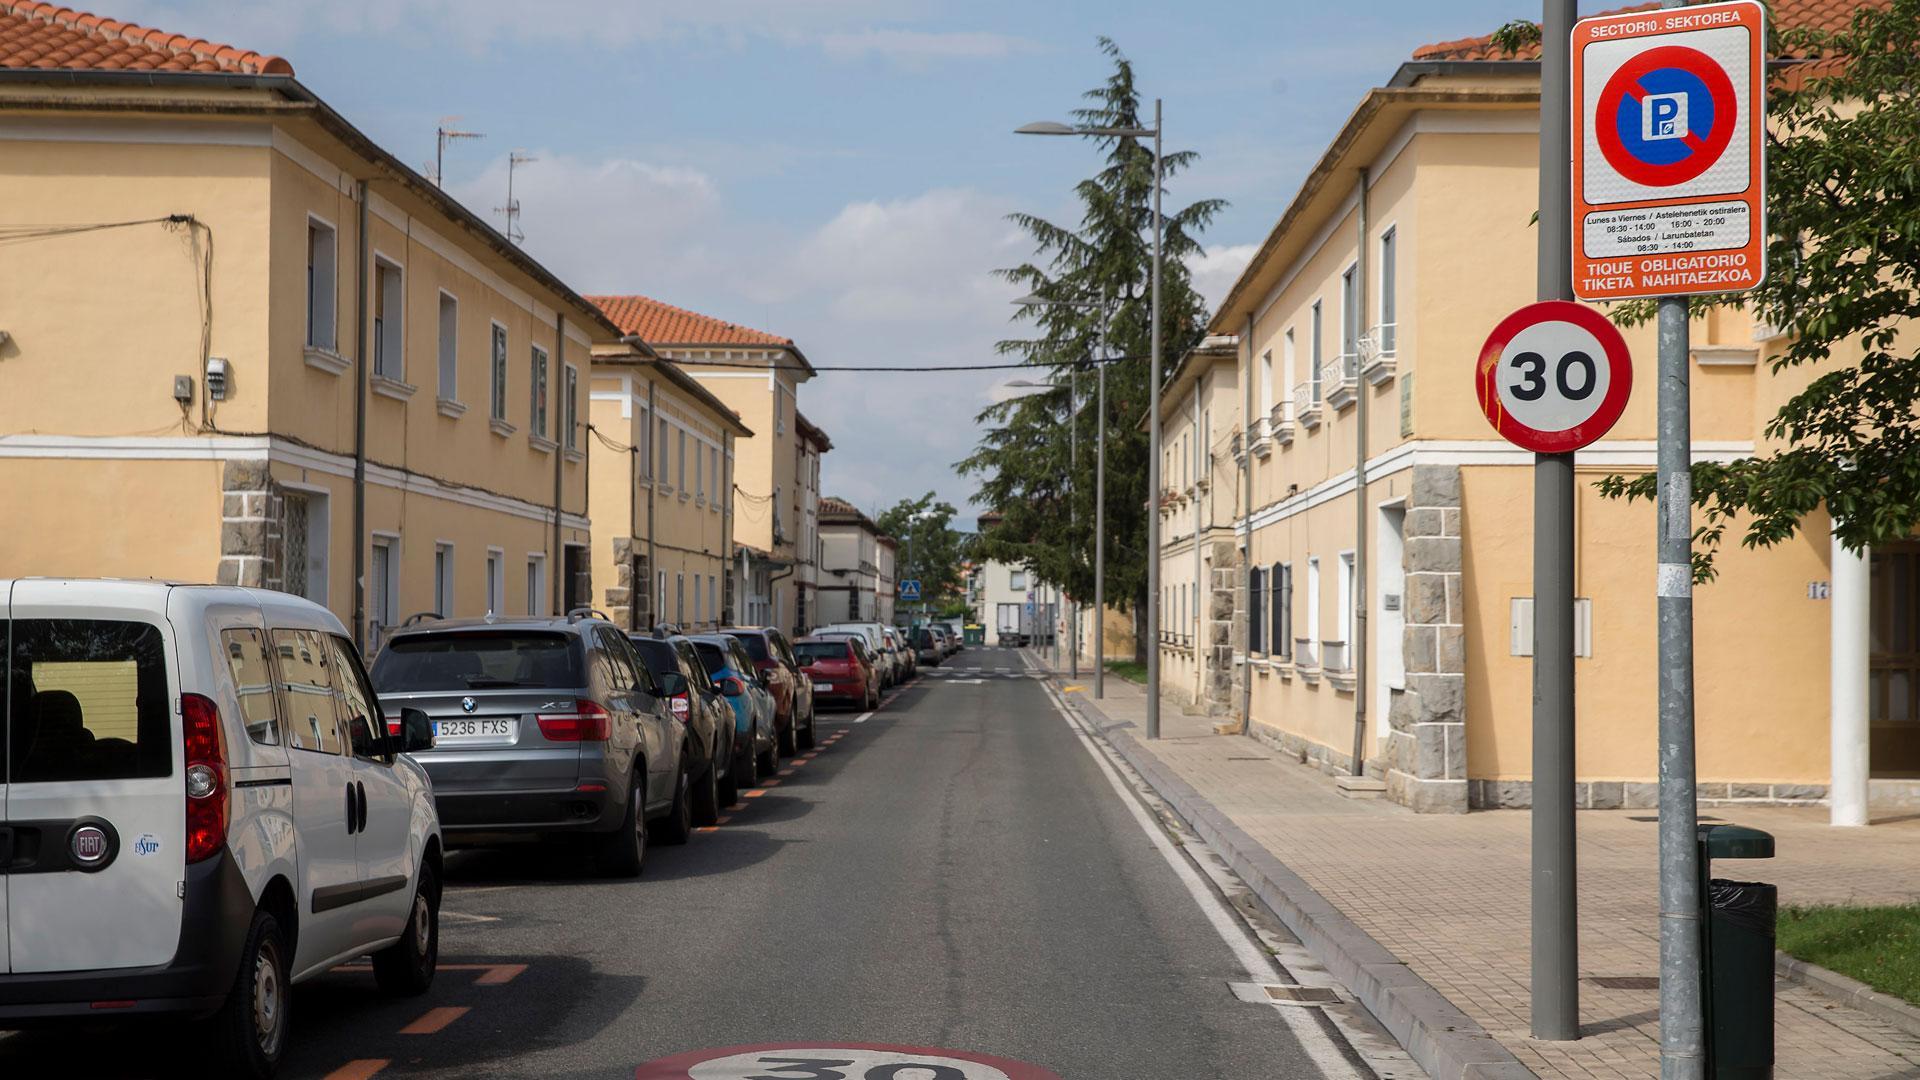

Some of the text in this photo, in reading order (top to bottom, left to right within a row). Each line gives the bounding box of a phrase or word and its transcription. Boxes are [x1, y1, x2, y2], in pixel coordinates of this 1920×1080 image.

[1666, 11, 1740, 29] SEKTOREA
[1587, 215, 1610, 225] Lunes
[1618, 213, 1646, 222] Viernes
[1655, 208, 1708, 220] Astelehenetik
[1709, 205, 1746, 215] ostiralera
[1606, 225, 1627, 233] 08:30
[1635, 223, 1655, 231] 14:00
[1671, 220, 1692, 229] 16:00
[1703, 218, 1725, 226] 20:00
[1617, 234, 1651, 243] Sábados
[1662, 230, 1714, 240] Larunbatetan
[1637, 244, 1658, 252] 08:30
[1673, 241, 1694, 250] 14:00
[1587, 253, 1747, 276] TIQUE OBLIGATORIO
[1583, 268, 1752, 291] TIKETA NAHITAEZKOA
[1509, 351, 1596, 401] 30
[1812, 581, 1827, 599] 17
[441, 720, 508, 735] 5236 FXS
[80, 837, 99, 852] FIAT
[743, 1057, 967, 1080] 30
